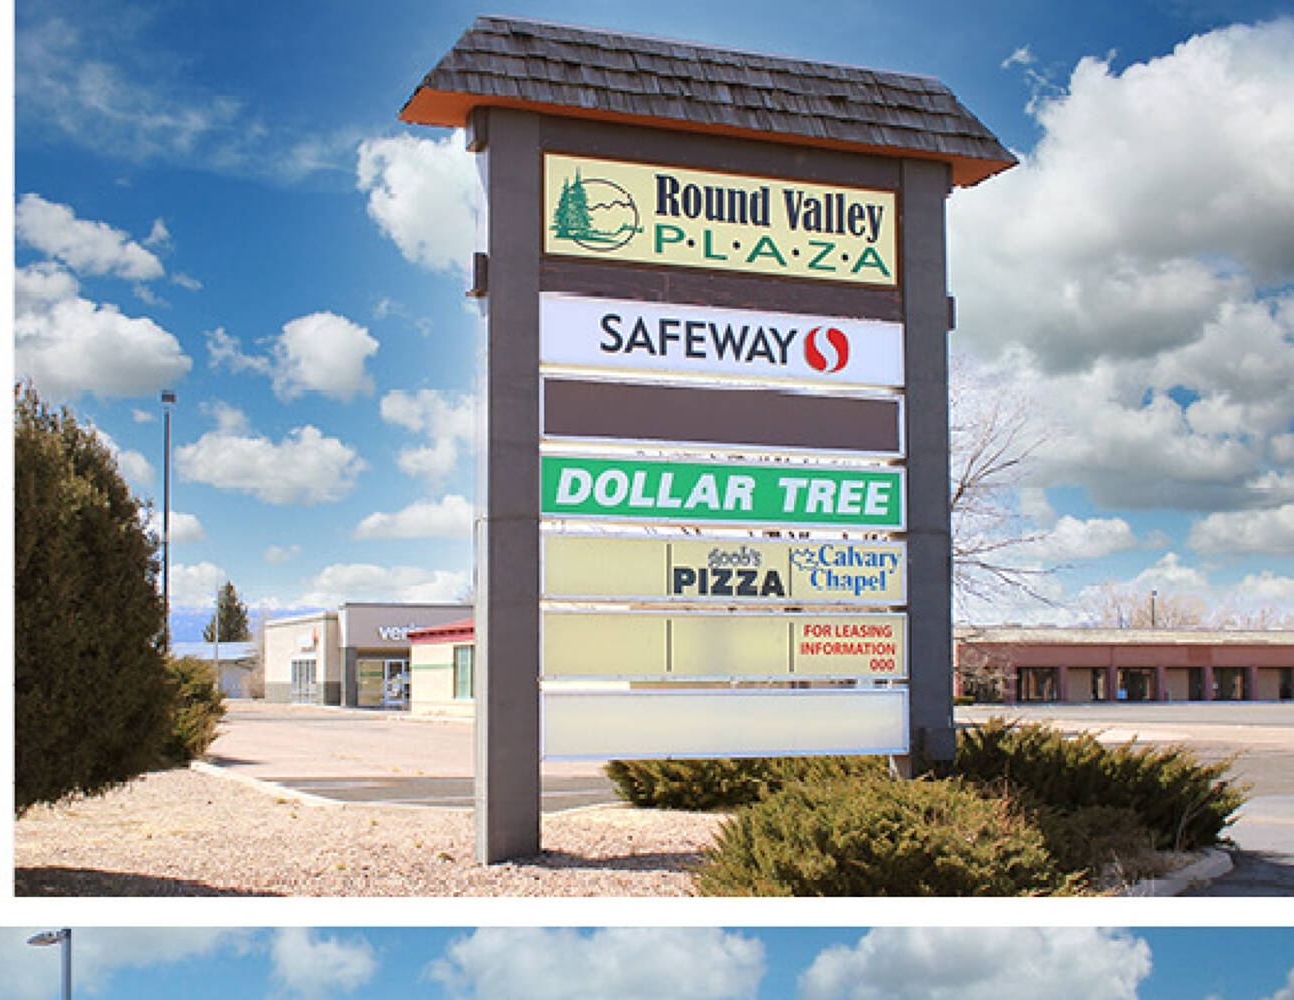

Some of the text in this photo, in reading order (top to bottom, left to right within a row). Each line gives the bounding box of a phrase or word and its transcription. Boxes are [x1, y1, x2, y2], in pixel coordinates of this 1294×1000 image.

[654, 173, 885, 243] Round Valley
[599, 313, 798, 366] SAFEWAY
[555, 467, 893, 515] DOLLAR TREE
[818, 544, 899, 574] Calvary
[673, 567, 785, 597] PIZZA
[810, 569, 887, 596] Chapel
[803, 624, 893, 638] FOR LEASING
[800, 641, 896, 656] INFORMATION
